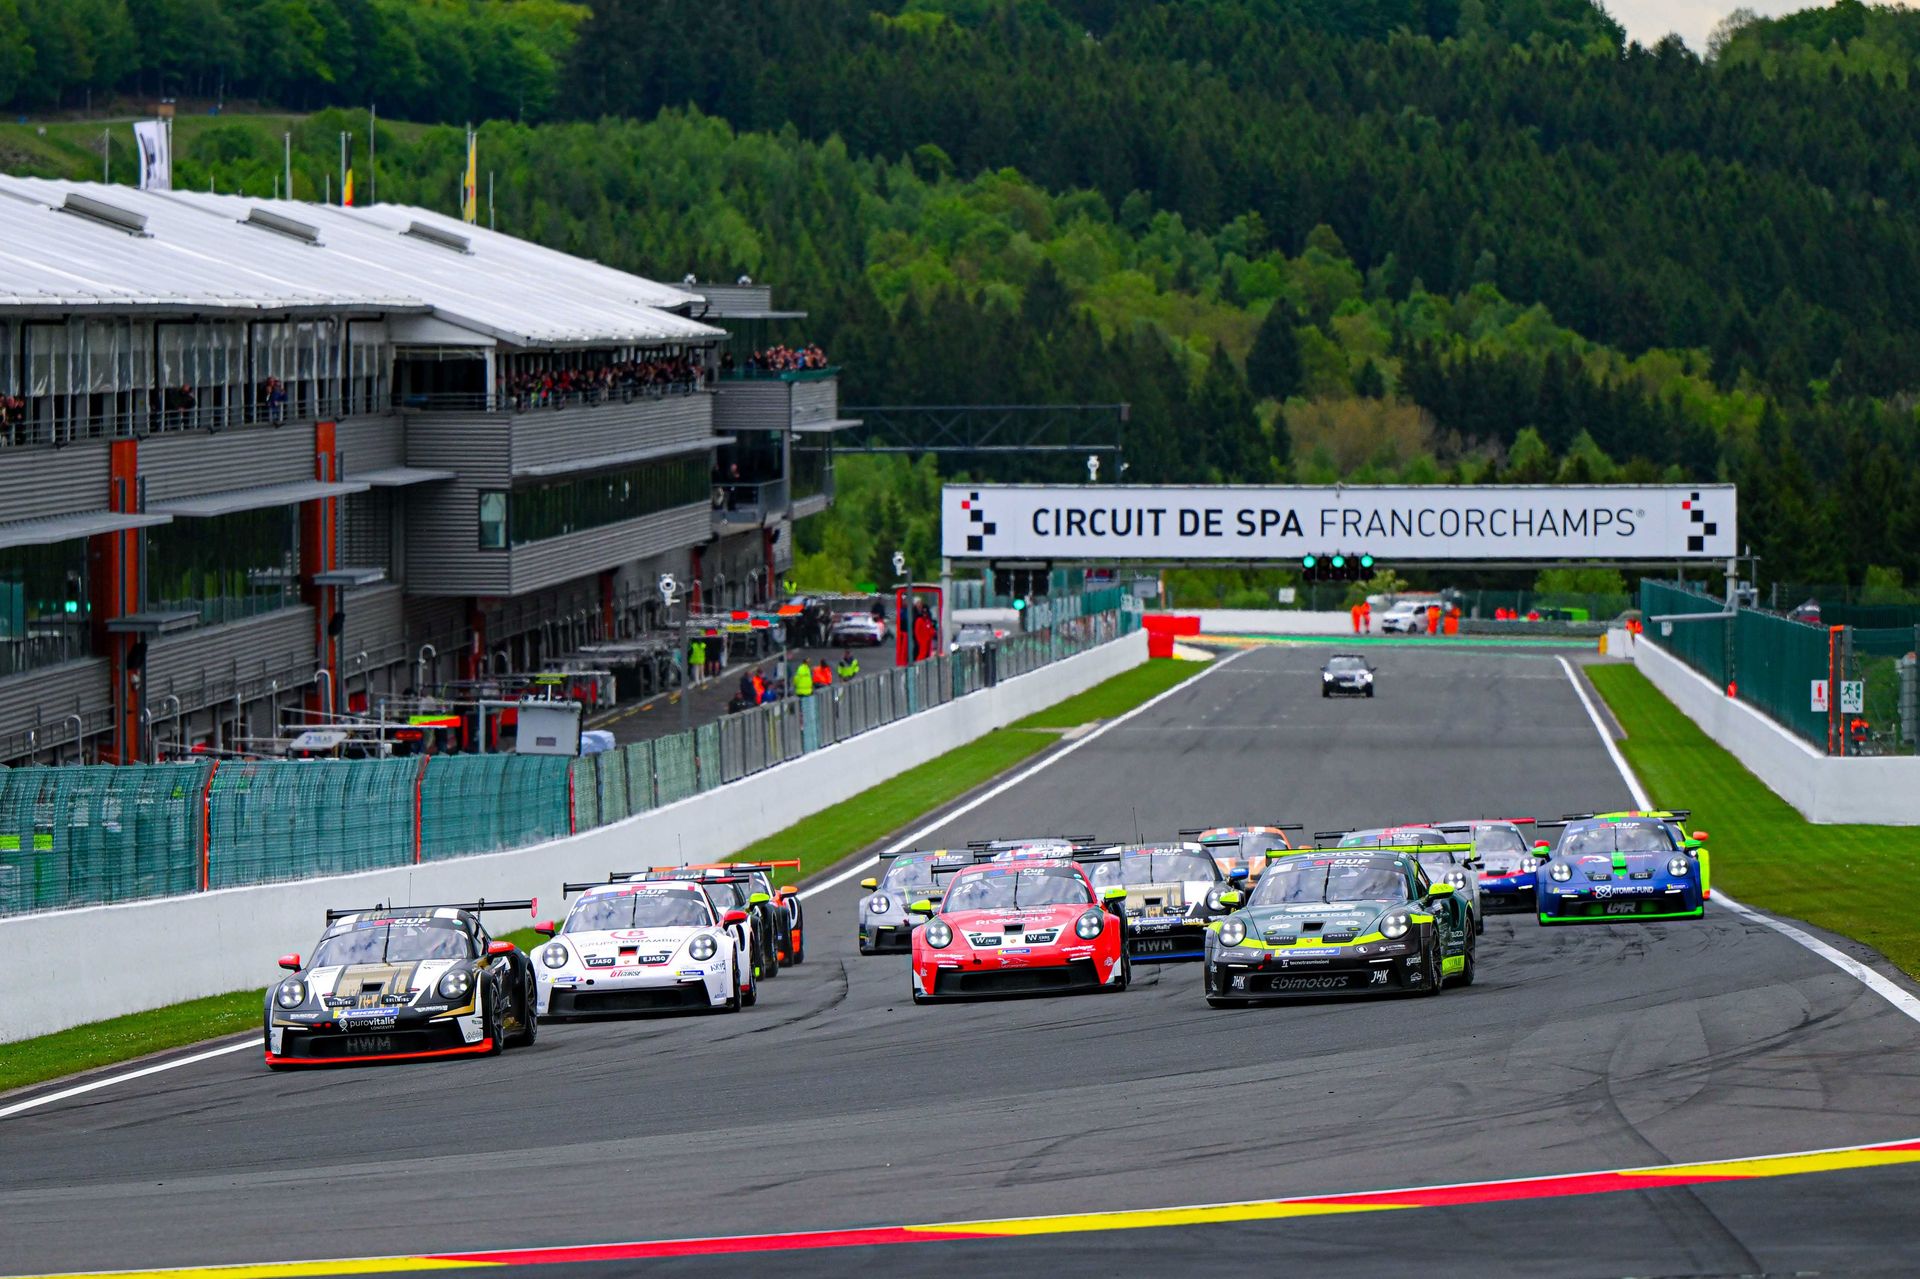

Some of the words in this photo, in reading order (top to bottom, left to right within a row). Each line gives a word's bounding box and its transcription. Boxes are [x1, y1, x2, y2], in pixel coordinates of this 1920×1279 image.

[1032, 508, 1167, 537] CIRCUIT
[1179, 508, 1223, 537] DE
[1236, 508, 1304, 537] SPA
[1095, 863, 1108, 875] 6
[952, 883, 974, 898] 22
[1612, 885, 1654, 894] ATOMIC.FUND
[976, 915, 1053, 926] RIVACOLD
[1181, 917, 1204, 925] Hertz
[1137, 939, 1173, 952] HWM
[1231, 975, 1246, 990] JHK
[1370, 969, 1389, 983] JHK
[351, 1008, 395, 1016] MICHELIN
[346, 1035, 392, 1053] HWM
